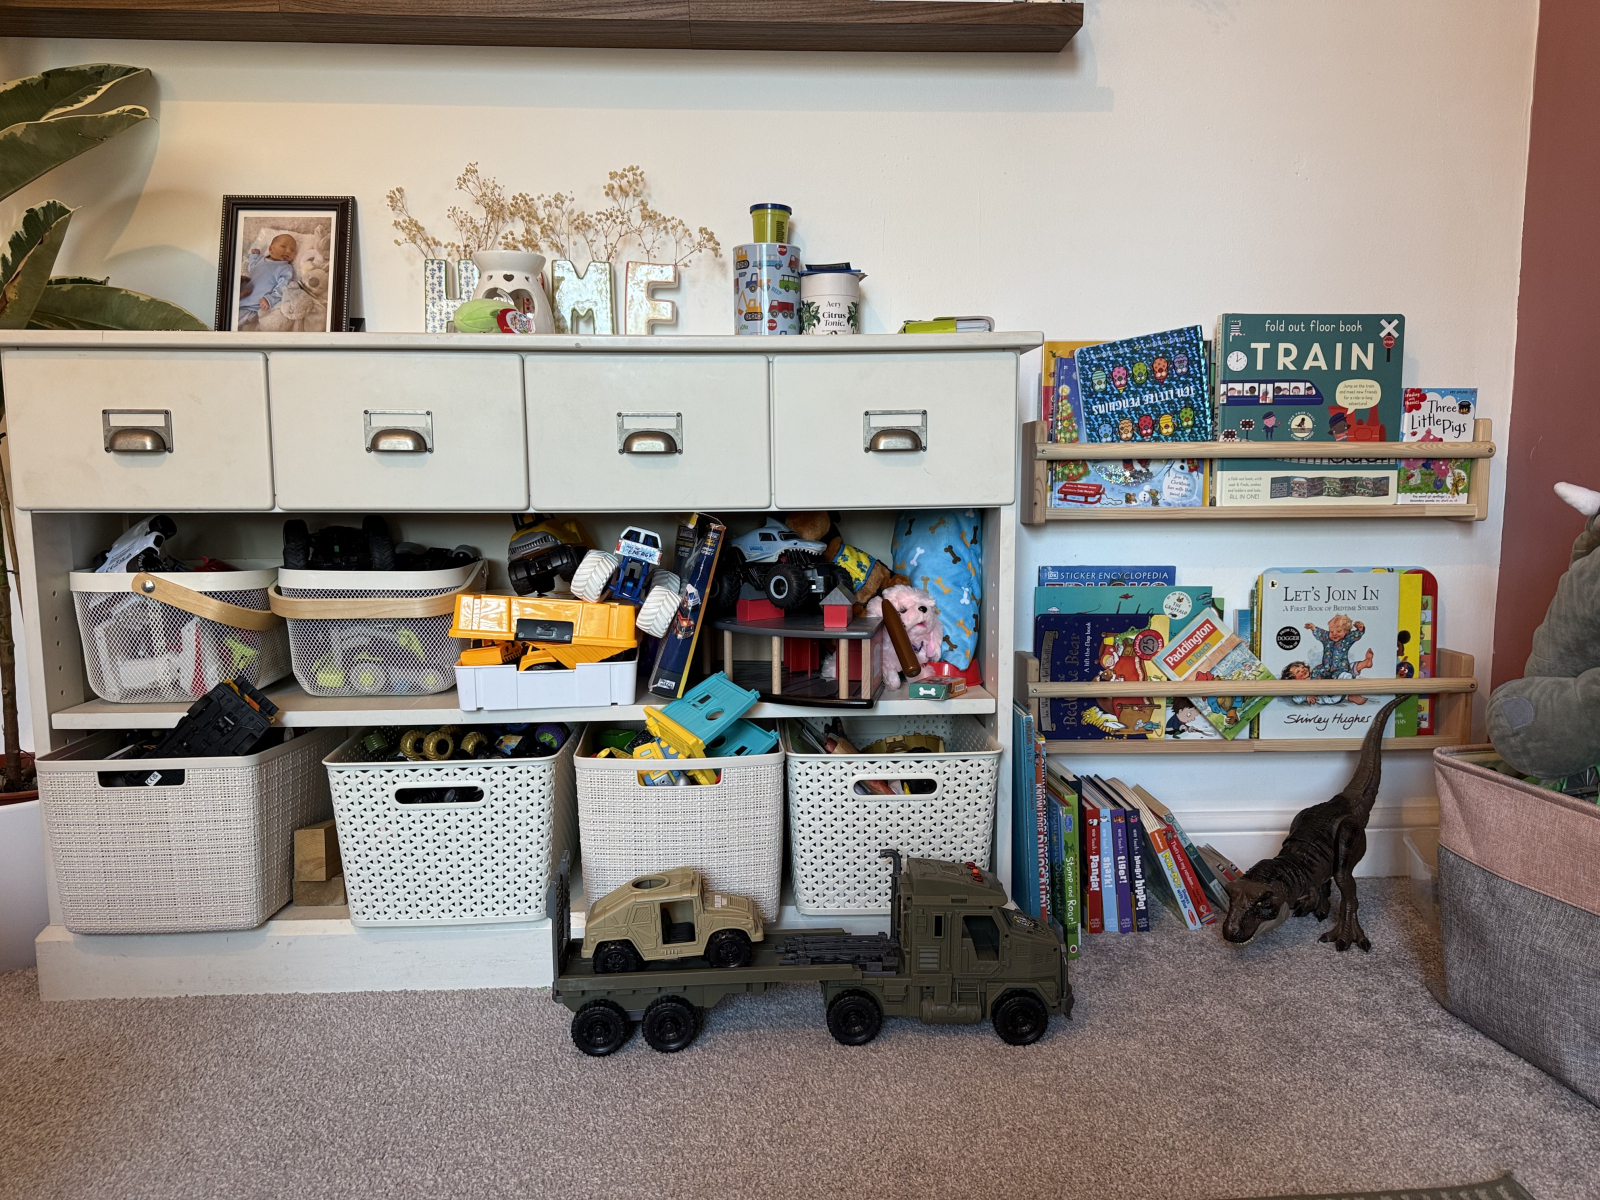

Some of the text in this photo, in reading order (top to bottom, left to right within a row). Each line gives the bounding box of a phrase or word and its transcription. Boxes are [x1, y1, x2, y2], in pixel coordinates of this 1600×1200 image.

[822, 311, 846, 319] Citrus
[1265, 320, 1362, 332] fold out floor book
[1250, 342, 1374, 371] TRAIN
[1142, 389, 1174, 405] LITTLE
[1427, 400, 1458, 413] Three
[1412, 413, 1442, 430] Little
[1443, 419, 1466, 438] Pigs
[1060, 572, 1169, 580] STICKER ENCYCLOPEDIA
[1283, 585, 1379, 603] LET'S JOIN IN
[1064, 632, 1080, 666] Bear
[1084, 635, 1092, 667] lift-the-flap
[1142, 638, 1155, 652] 25
[1165, 623, 1214, 666] Paddington
[1185, 642, 1212, 667] in Touch
[1284, 713, 1372, 731] Shirley Hughes
[1134, 855, 1143, 879] hungry
[1171, 840, 1179, 854] That's
[1180, 862, 1186, 870] my
[1065, 856, 1075, 883] Stomp
[1090, 855, 1100, 891] panda!
[1103, 856, 1113, 888] shark!
[1117, 855, 1127, 884] tiger!
[1134, 879, 1146, 910] hippo!
[1182, 888, 1190, 904] Shapes
[1066, 899, 1077, 925] Roar!
